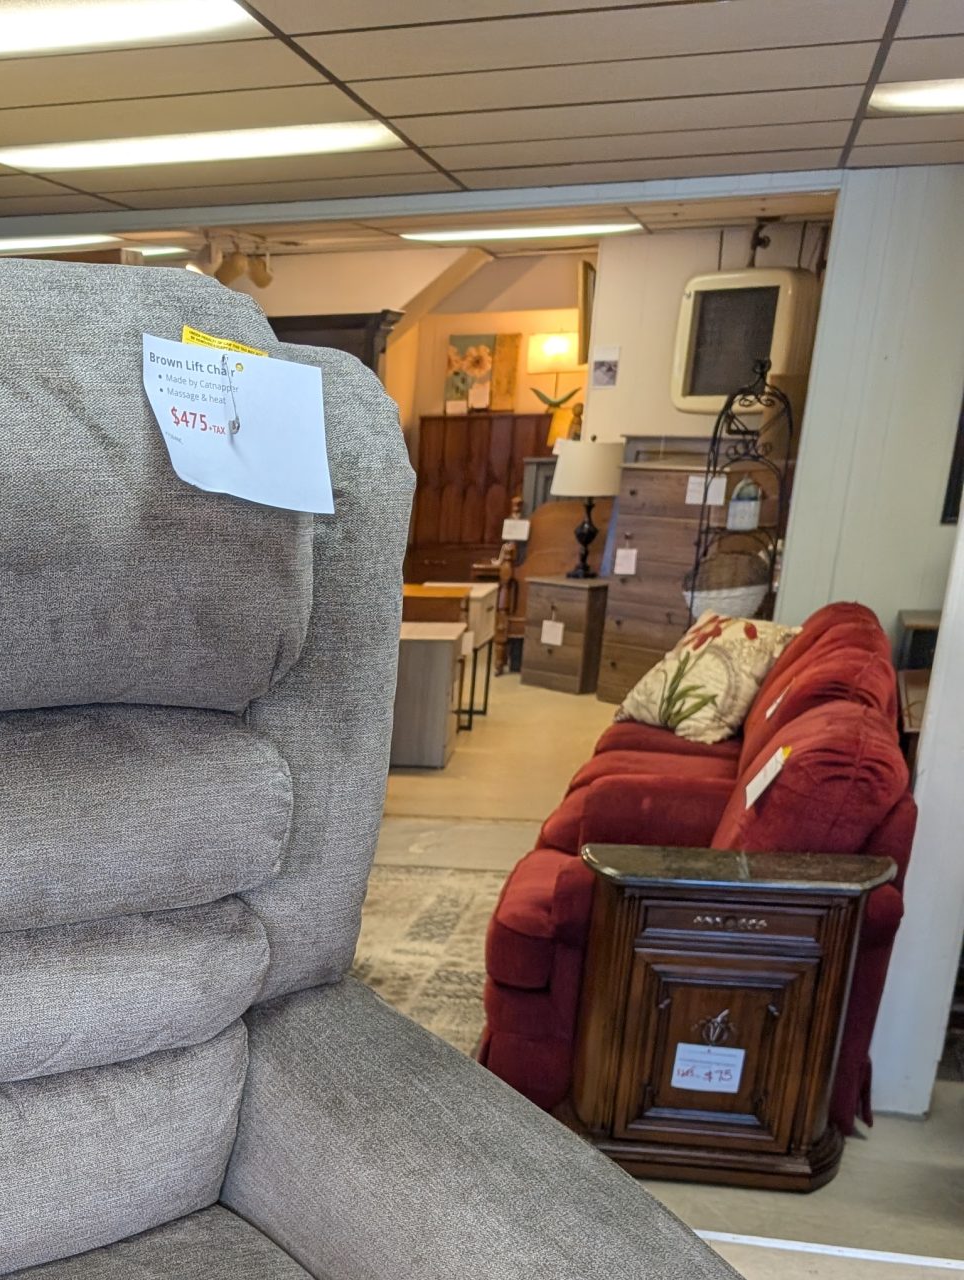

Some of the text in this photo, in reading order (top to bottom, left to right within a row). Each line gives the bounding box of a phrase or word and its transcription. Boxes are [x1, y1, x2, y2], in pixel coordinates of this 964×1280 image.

[149, 351, 236, 377] Brown Lift Char
[165, 373, 239, 393] Made by Catnapper
[166, 387, 227, 405] Massage & heat
[170, 405, 209, 432] $475
